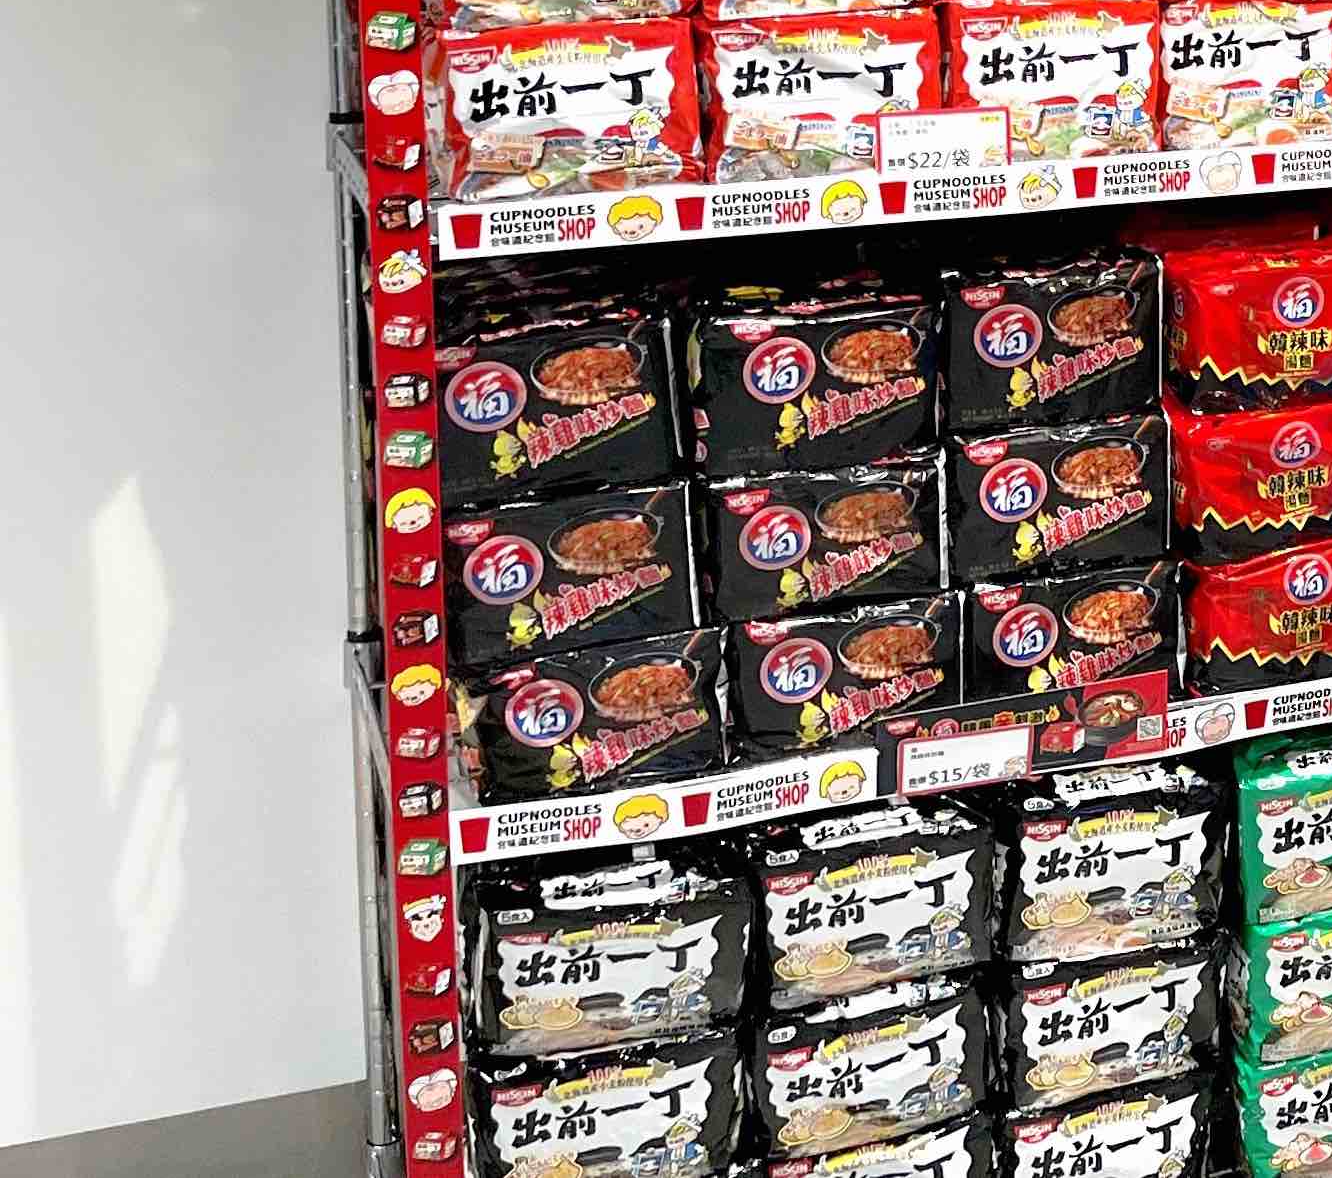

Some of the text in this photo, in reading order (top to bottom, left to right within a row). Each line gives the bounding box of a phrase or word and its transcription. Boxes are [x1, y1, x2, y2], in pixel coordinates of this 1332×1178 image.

[979, 40, 1140, 86] 出前一丁
[1172, 24, 1320, 69] 出前一丁
[470, 66, 654, 121] 出前一丁
[733, 59, 905, 99] 出前一丁
[908, 148, 970, 169] $22/袋
[1103, 159, 1190, 175] CUPNOODLES
[712, 188, 810, 206] CUPNOODLES
[914, 174, 1006, 190] CUPNOODLES
[973, 185, 1007, 208] SHOP
[1160, 168, 1190, 193] SHOP
[490, 205, 595, 223] CUPNOODLES
[490, 217, 595, 242] MUSEUM SHOP
[712, 199, 810, 224] MUSEUM SHOP
[1282, 283, 1312, 321] 福
[987, 314, 1028, 357] 福
[756, 348, 799, 393] 福
[459, 374, 506, 423] 福
[993, 472, 1032, 512] 福
[476, 551, 527, 592] 福
[774, 655, 817, 692] 福
[1273, 697, 1321, 715] MUSEUM
[717, 770, 810, 798] CUPNOODLES
[775, 782, 810, 811] SHOP
[498, 805, 602, 824] CUPNOODLES
[498, 816, 602, 841] MUSEUM SHOP
[1036, 832, 1194, 885] 出前一丁
[786, 870, 955, 936] 出前一丁
[515, 933, 700, 988] 出前一丁
[1038, 977, 1178, 1047] 出前一丁
[785, 1028, 946, 1104] 出前一丁
[514, 1075, 700, 1148] 出前一丁
